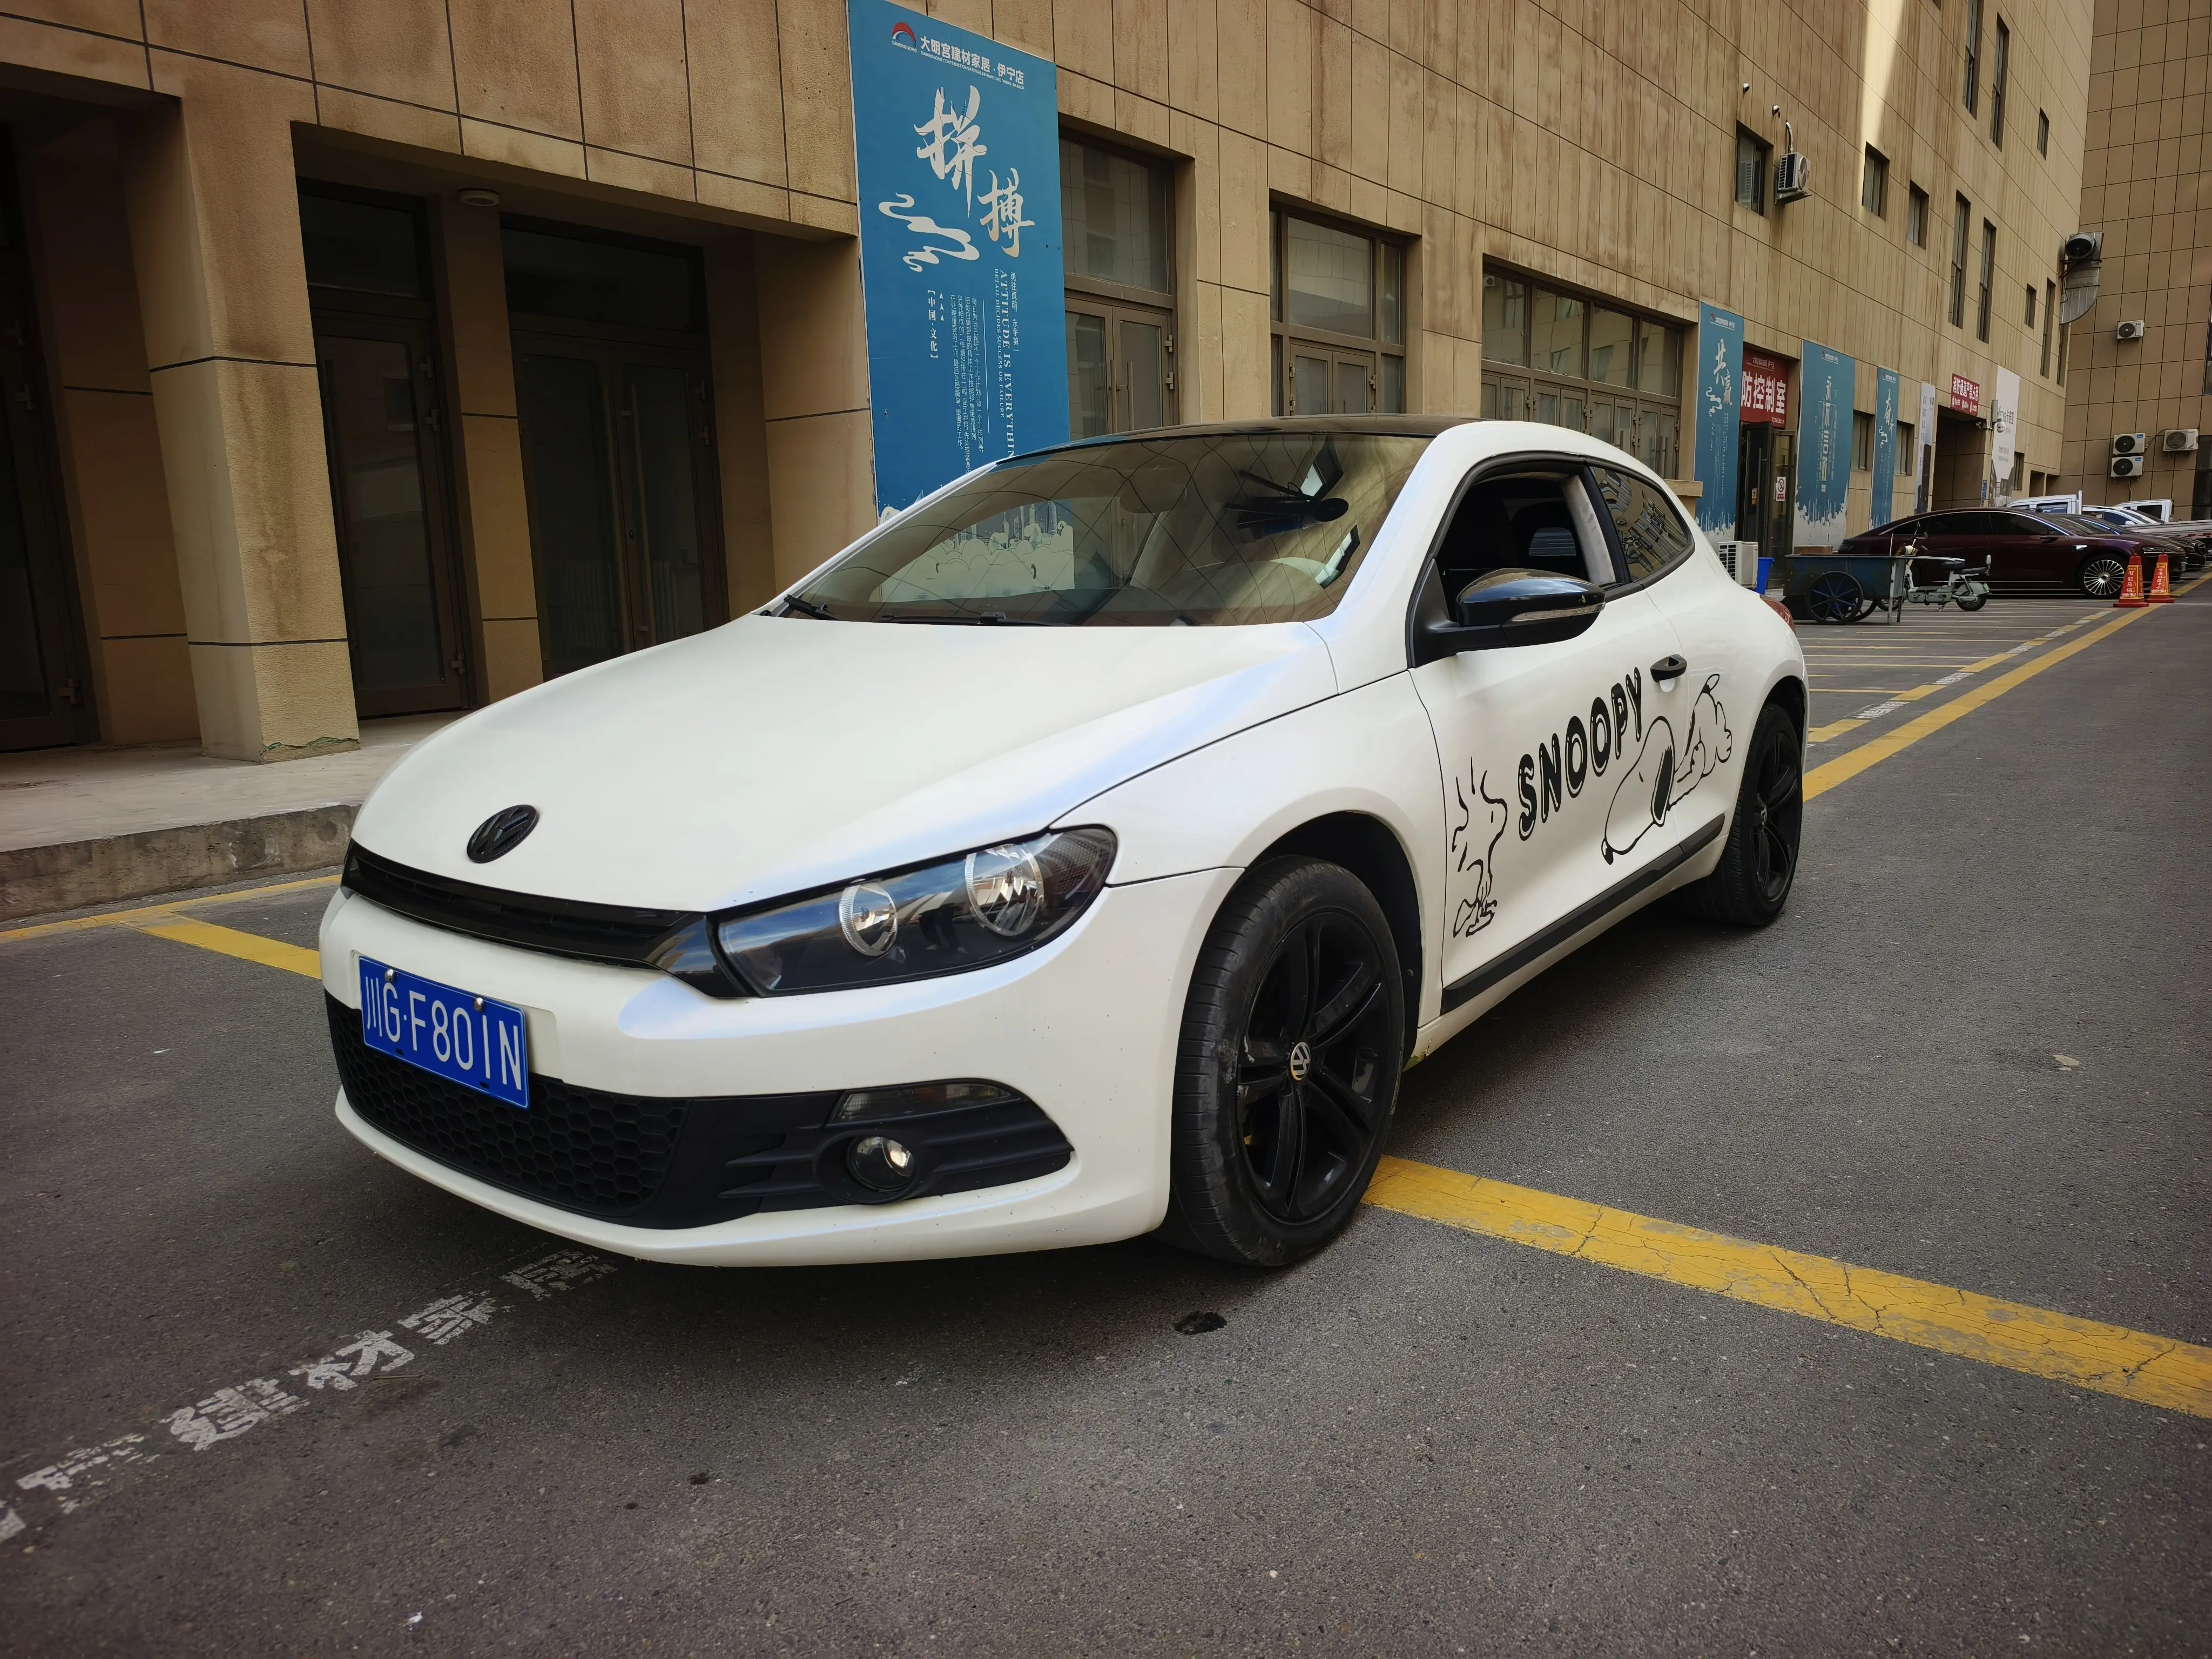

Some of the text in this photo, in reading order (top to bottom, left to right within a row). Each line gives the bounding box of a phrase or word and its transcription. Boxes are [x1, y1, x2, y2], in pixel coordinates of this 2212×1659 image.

[1000, 270, 1010, 348] ATTITUDE
[999, 371, 1003, 382] OR
[1003, 353, 1011, 367] IS
[1741, 370, 1786, 414] 防控制室
[1518, 667, 1642, 841] SNOOPY
